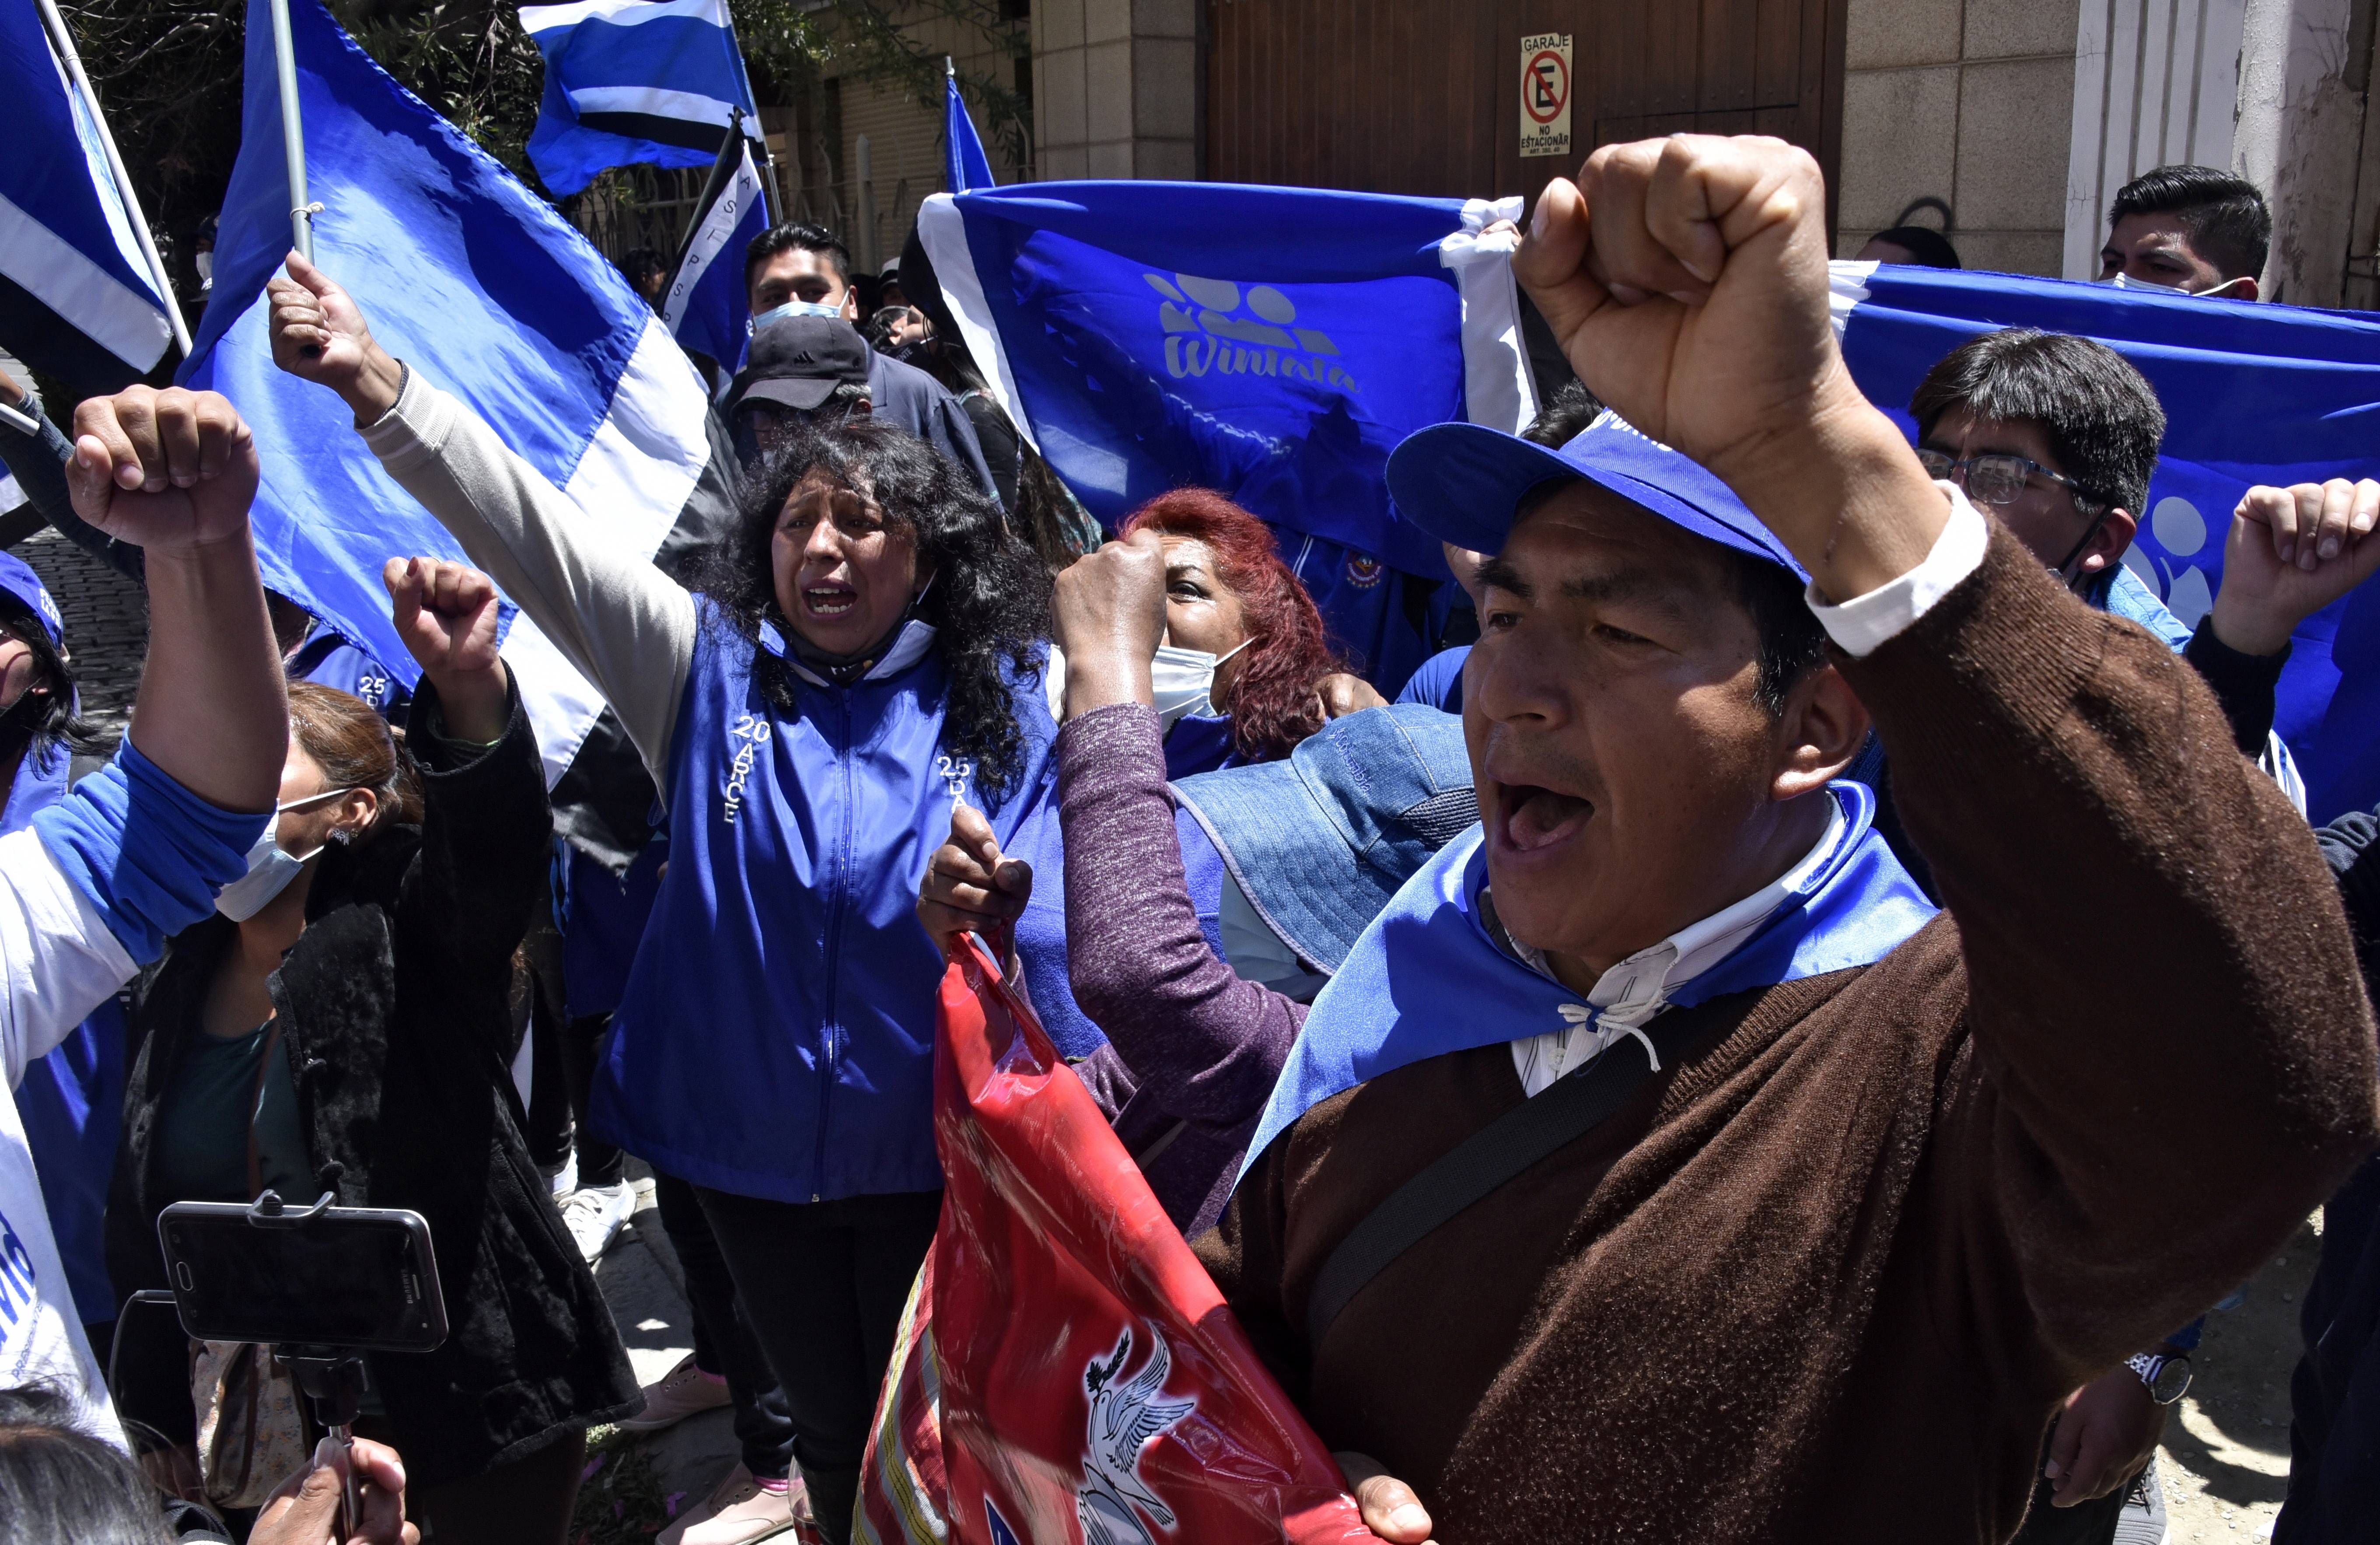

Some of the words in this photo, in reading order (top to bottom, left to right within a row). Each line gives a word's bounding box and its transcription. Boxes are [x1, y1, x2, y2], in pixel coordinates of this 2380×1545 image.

[1524, 35, 1569, 51] GARAJE
[1539, 125, 1550, 136] NO
[1521, 134, 1569, 148] ESTACIONAR
[360, 676, 385, 694] 25
[367, 695, 378, 710] D
[731, 716, 771, 742] 20
[937, 756, 970, 777] 25
[1336, 735, 1372, 792] Columbia
[723, 743, 753, 824] ARCE
